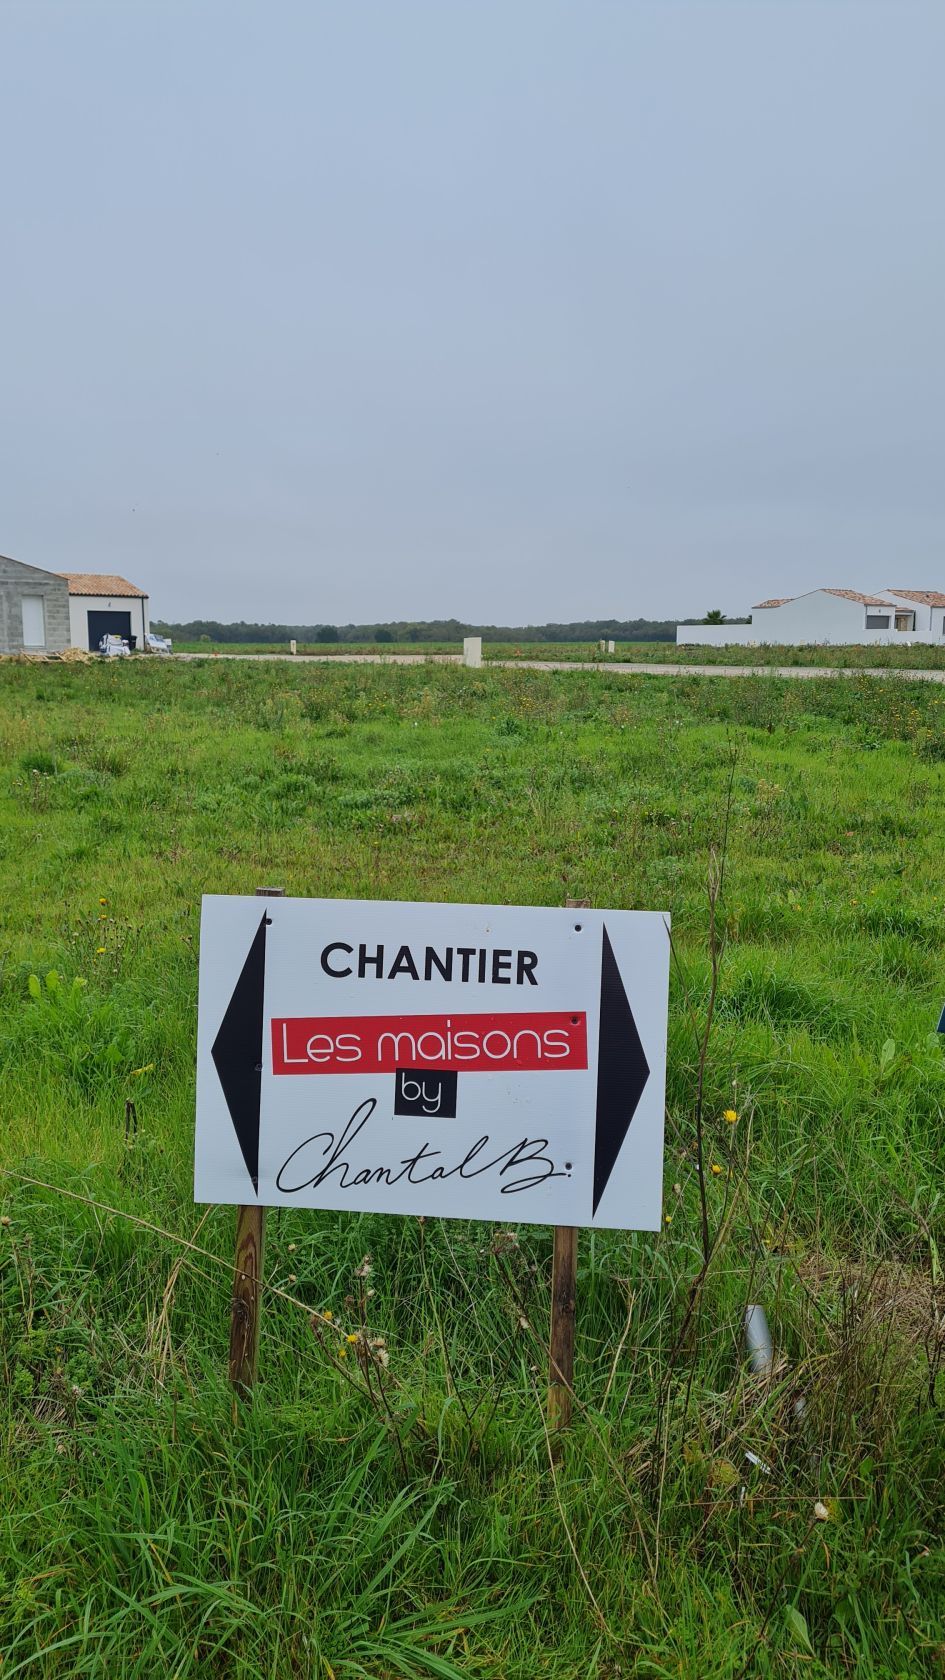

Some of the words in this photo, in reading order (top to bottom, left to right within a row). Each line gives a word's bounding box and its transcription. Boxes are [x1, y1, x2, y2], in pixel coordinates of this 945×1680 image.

[320, 941, 539, 986] CHANTIER
[282, 1022, 363, 1064] Les
[377, 1018, 571, 1062] maisons
[401, 1072, 442, 1114] by
[276, 1097, 493, 1194] Chantal
